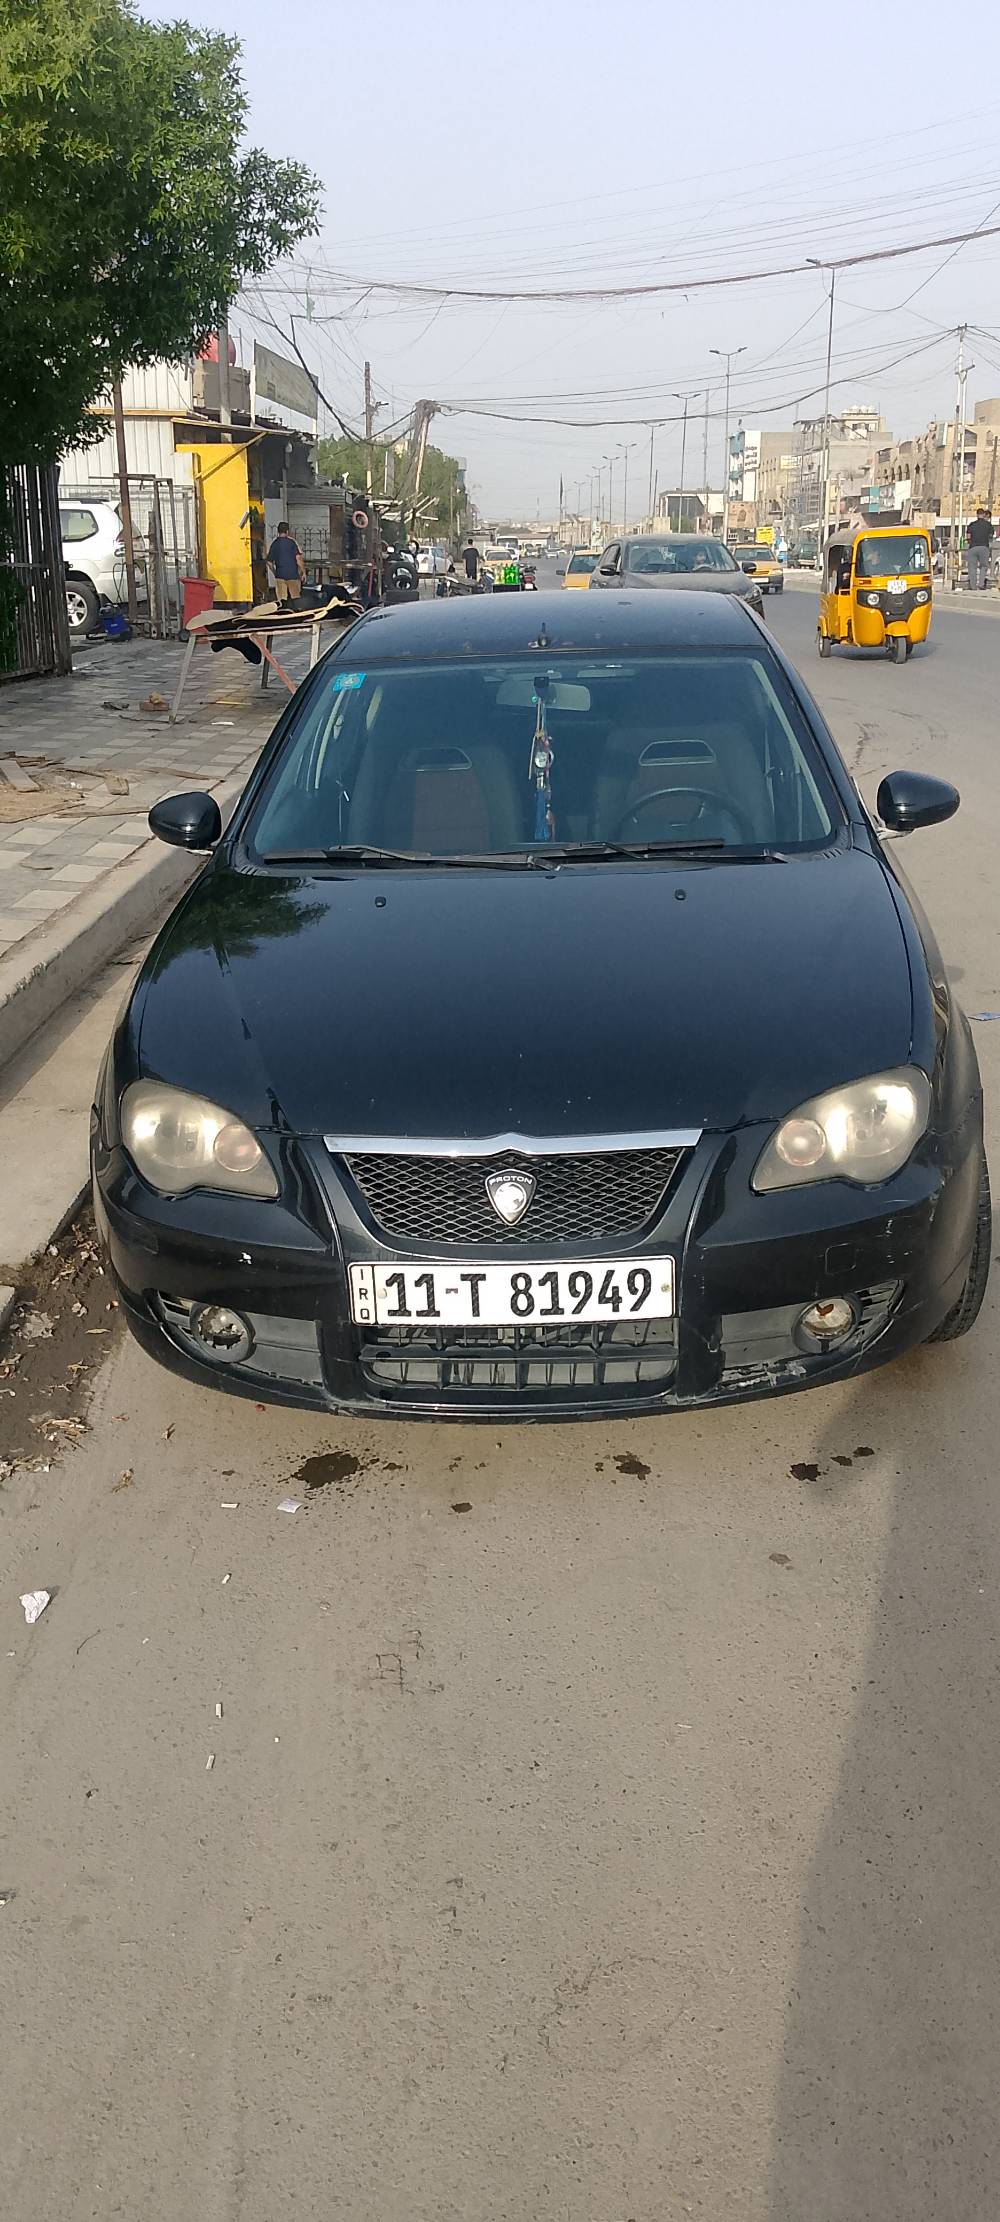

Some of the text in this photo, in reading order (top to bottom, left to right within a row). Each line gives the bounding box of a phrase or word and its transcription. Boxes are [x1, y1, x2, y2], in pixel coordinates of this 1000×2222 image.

[489, 1175, 533, 1186] PROTON
[359, 1269, 370, 1320] IRQ
[510, 1268, 652, 1317] 81949
